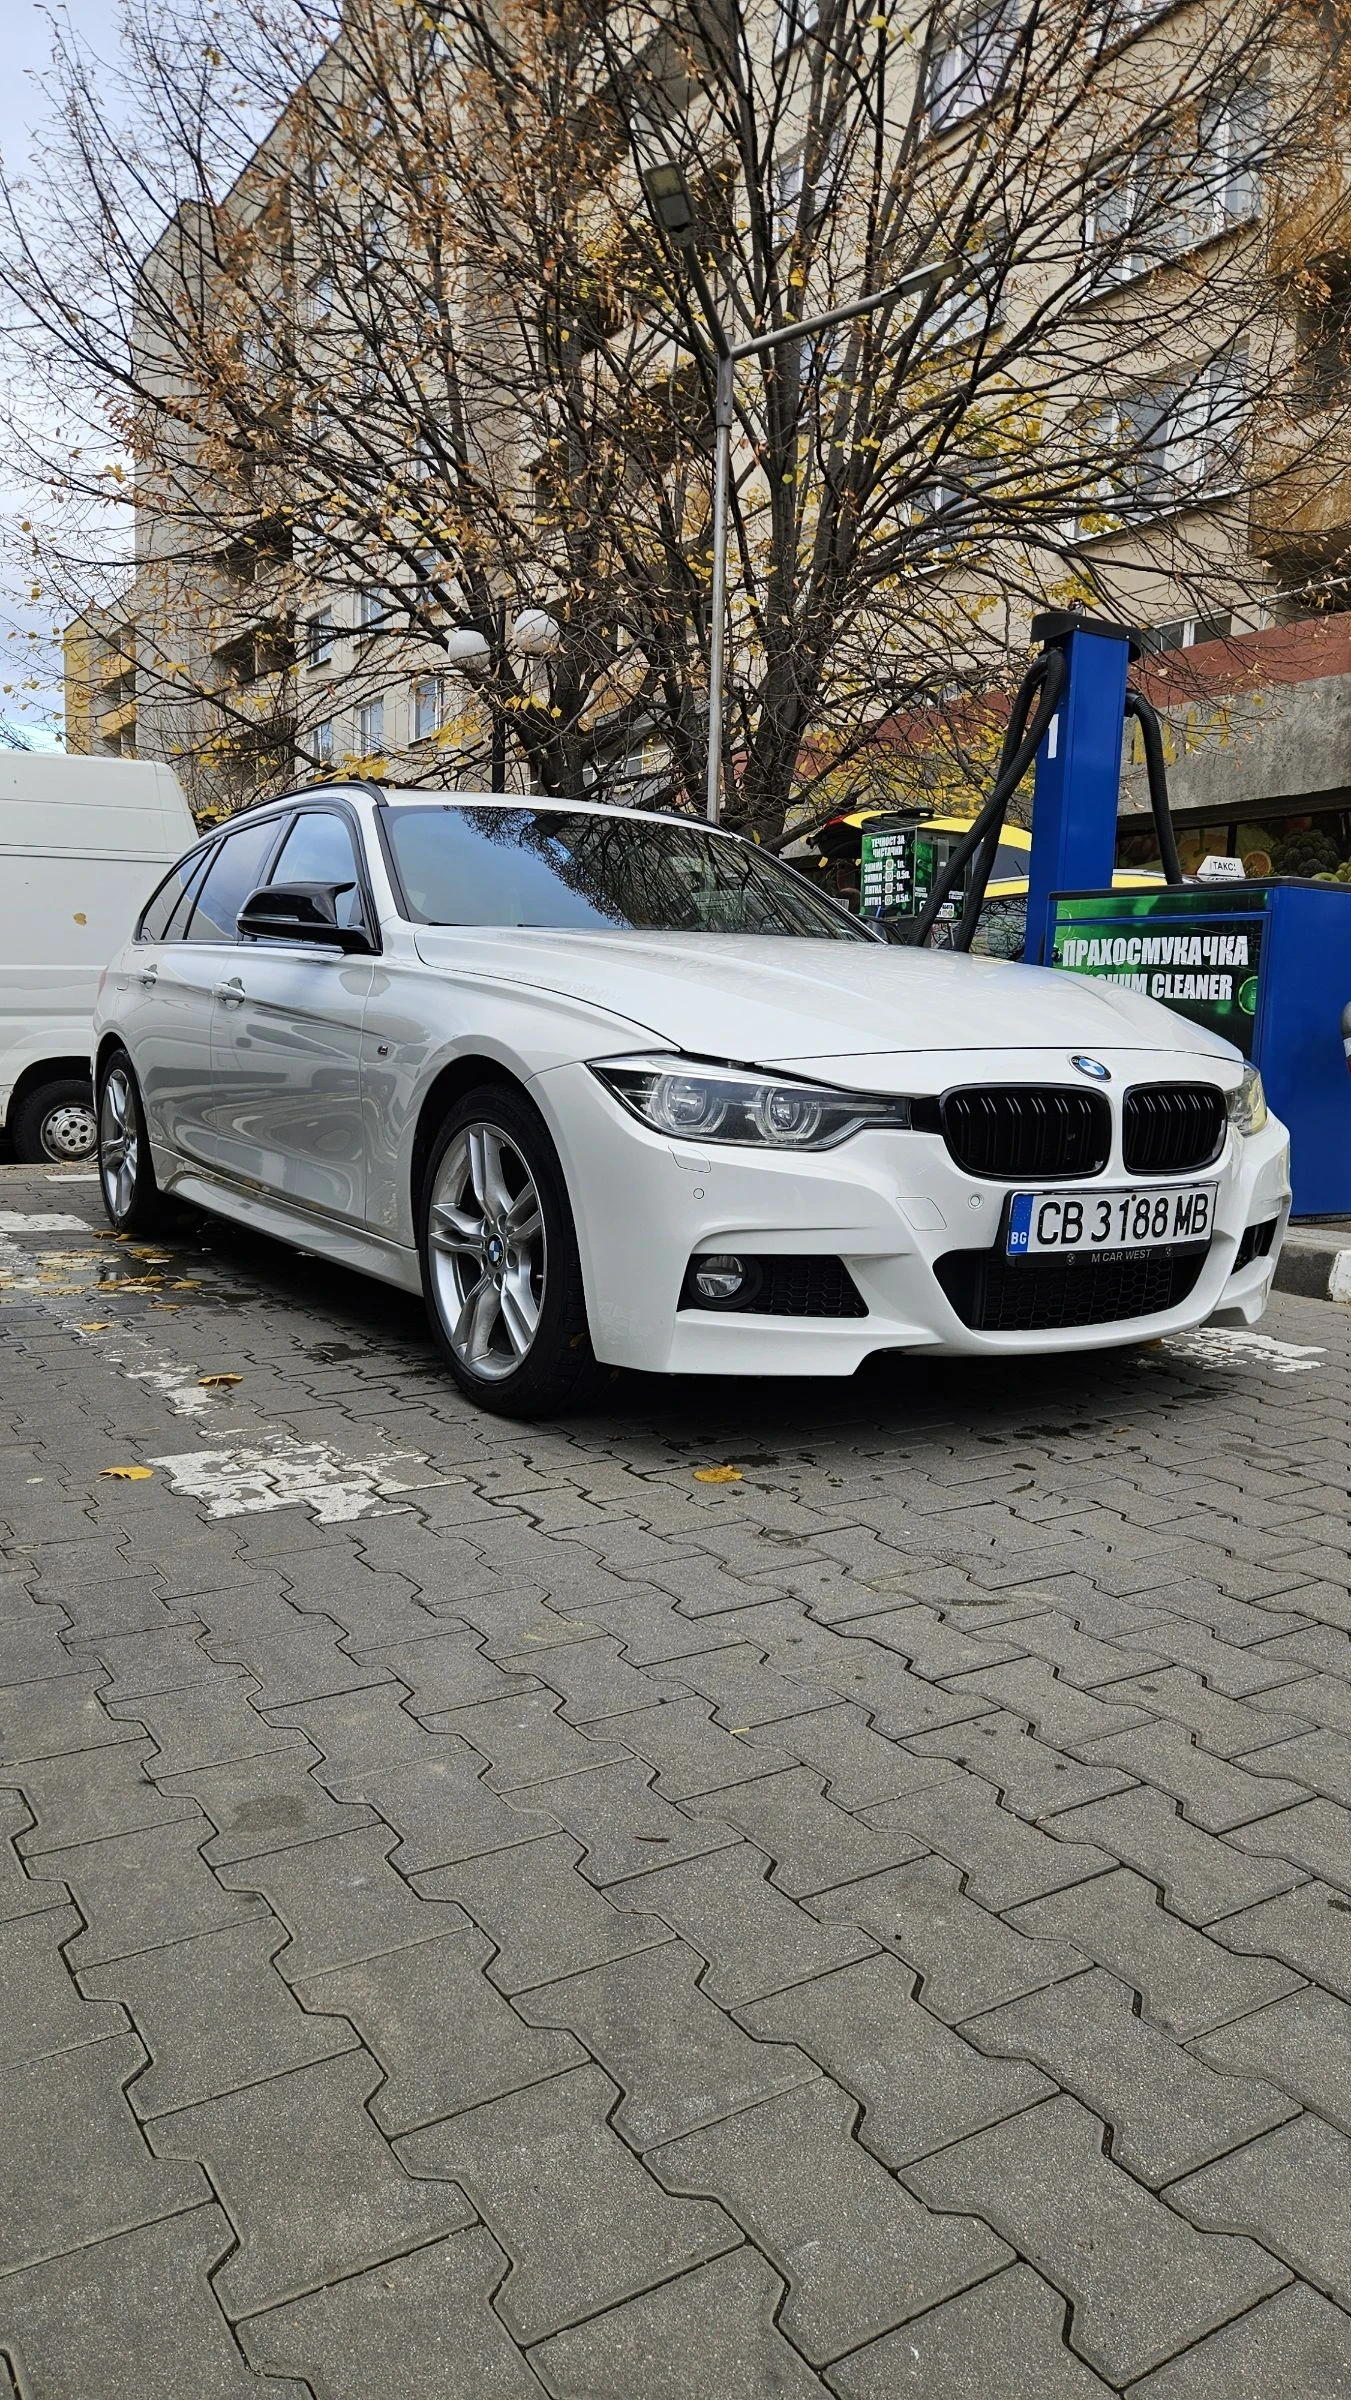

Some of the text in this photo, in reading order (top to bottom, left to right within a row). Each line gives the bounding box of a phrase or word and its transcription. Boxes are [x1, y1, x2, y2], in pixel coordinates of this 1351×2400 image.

[1047, 713, 1060, 759] 1
[871, 834, 905, 848] ТЕЧНОСТ ЗА
[1062, 935, 1249, 967] ПРАХОСМУКАЧКА
[1151, 973, 1233, 1001] CLEANER
[1037, 1192, 1209, 1246] CB 3188 MB
[1010, 1231, 1027, 1245] BG
[1091, 1249, 1153, 1263] M CAR WEST
